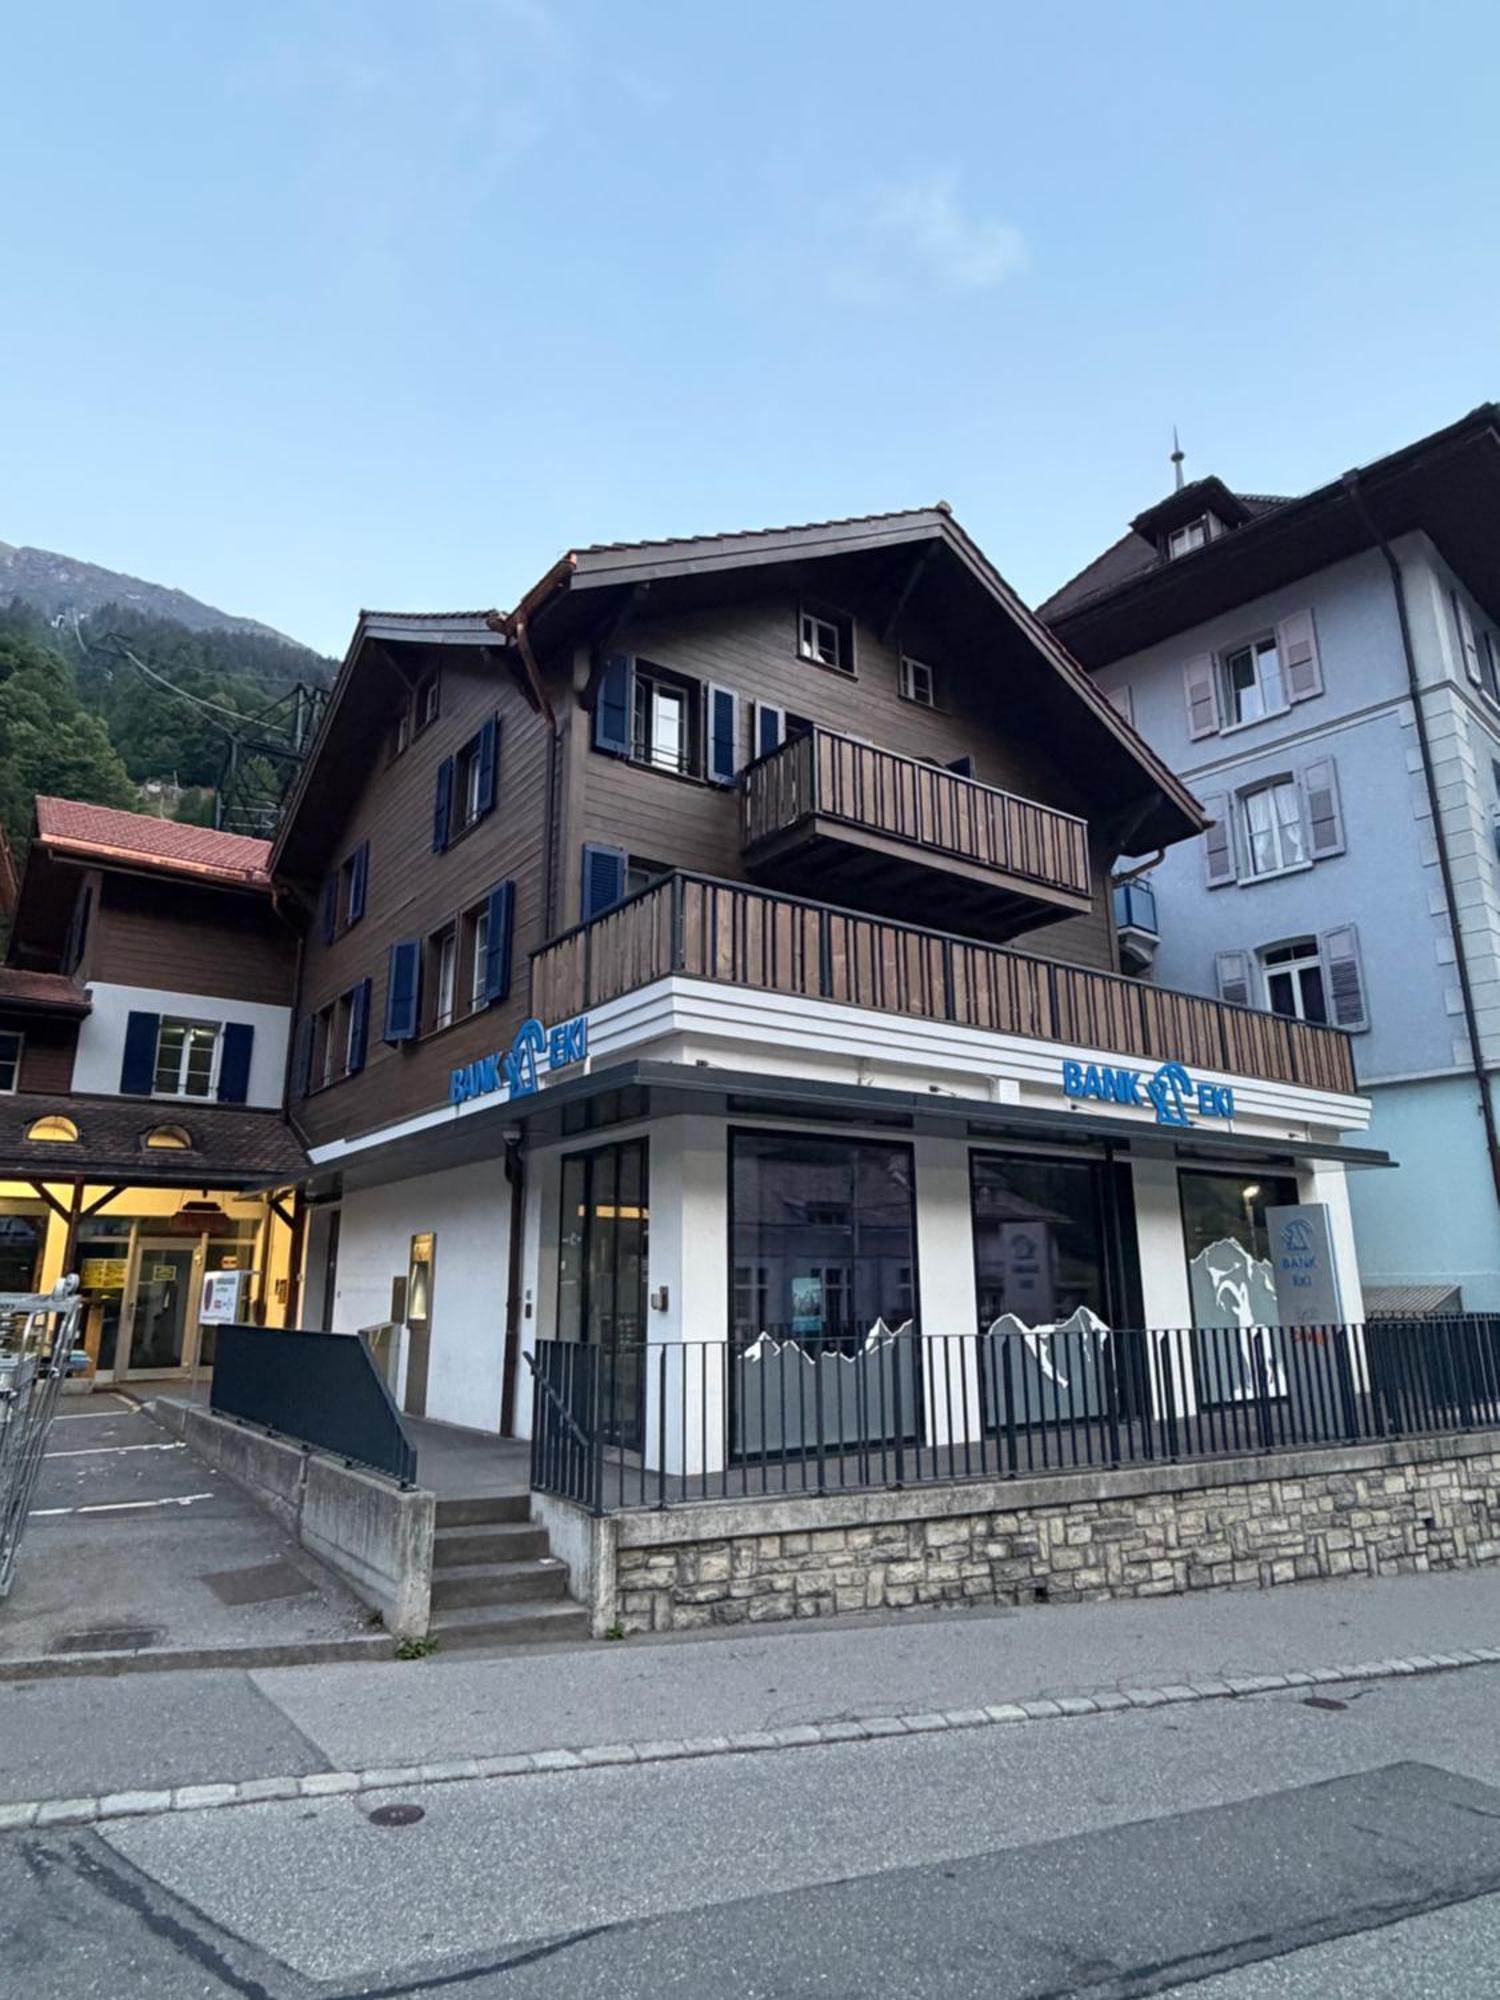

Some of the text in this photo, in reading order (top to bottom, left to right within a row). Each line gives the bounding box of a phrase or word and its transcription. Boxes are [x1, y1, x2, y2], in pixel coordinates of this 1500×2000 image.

[449, 1017, 587, 1104] BANK EKI
[1063, 1060, 1234, 1118] BANK EKI
[1281, 1256, 1316, 1269] BANK
[1292, 1275, 1312, 1287] EKI
